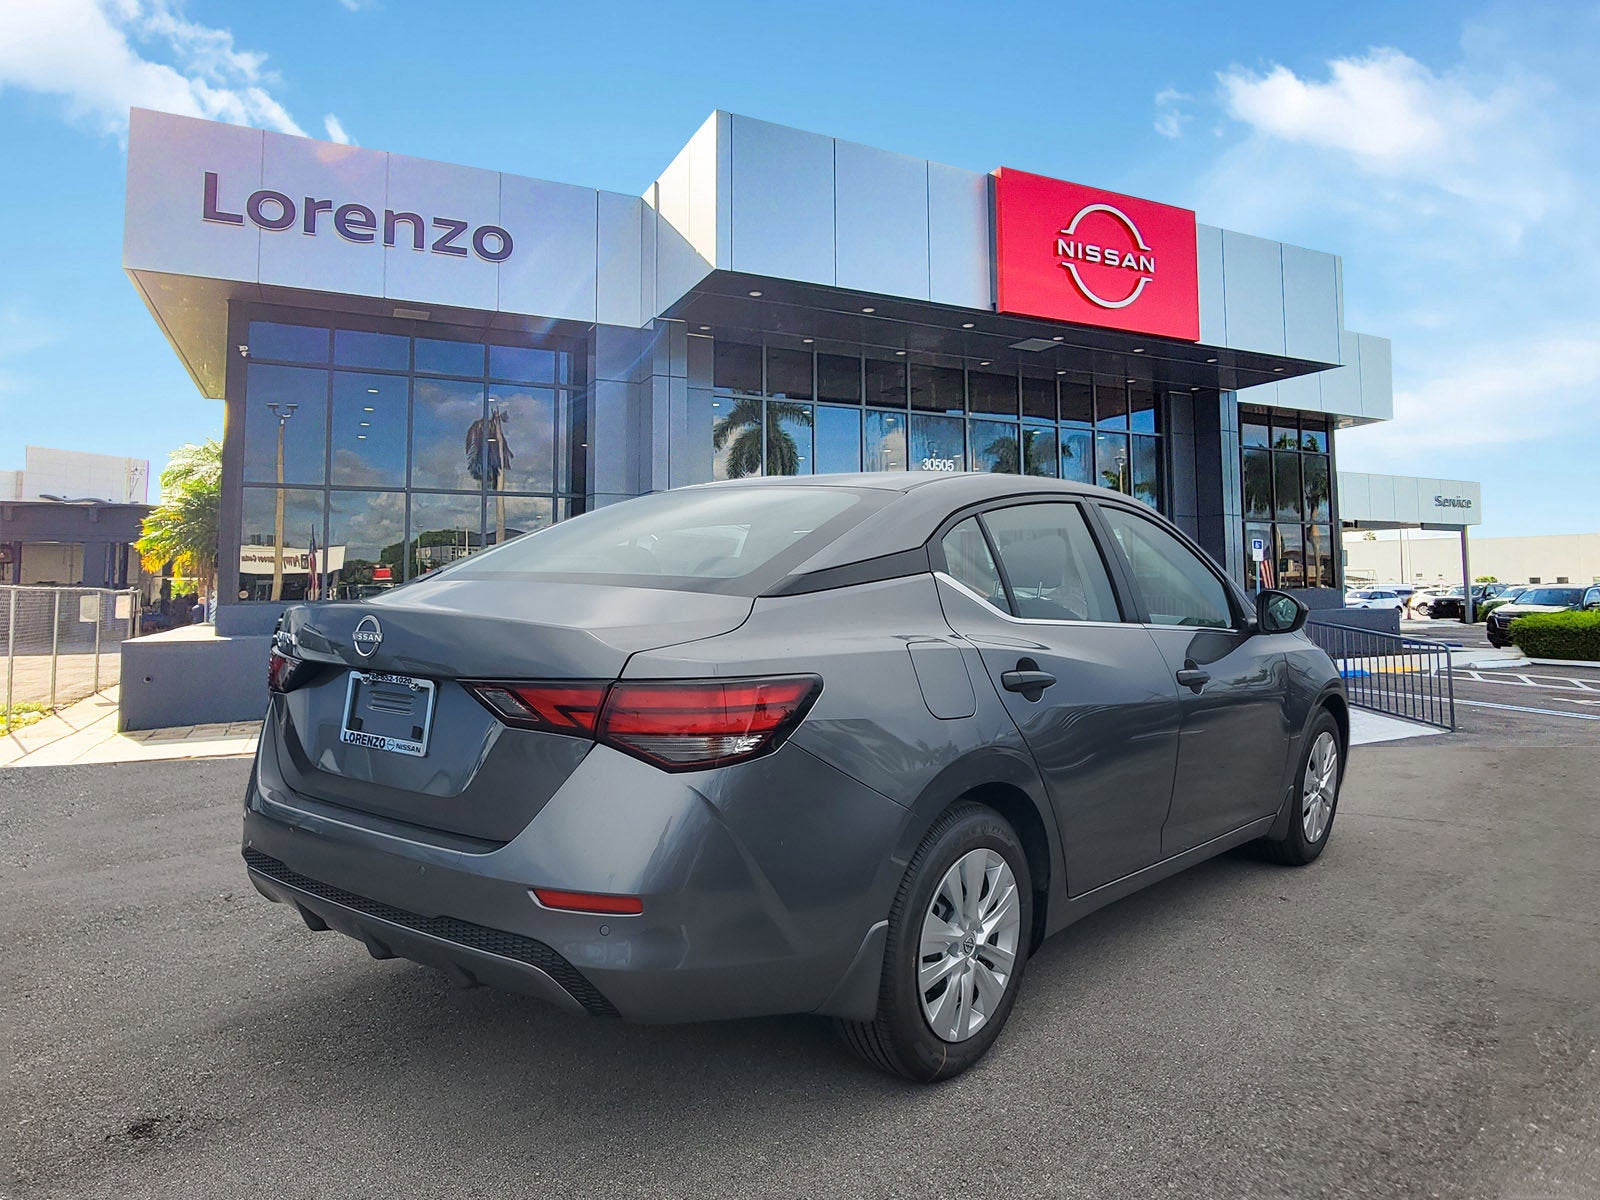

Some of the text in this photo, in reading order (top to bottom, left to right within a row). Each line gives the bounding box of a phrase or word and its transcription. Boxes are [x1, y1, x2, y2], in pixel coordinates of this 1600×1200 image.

[202, 171, 515, 263] Lorenzo
[1057, 238, 1155, 273] NISSAN
[922, 457, 954, 471] 30505
[1434, 495, 1472, 509] Service
[343, 730, 421, 754] LORENZO NISSAN
